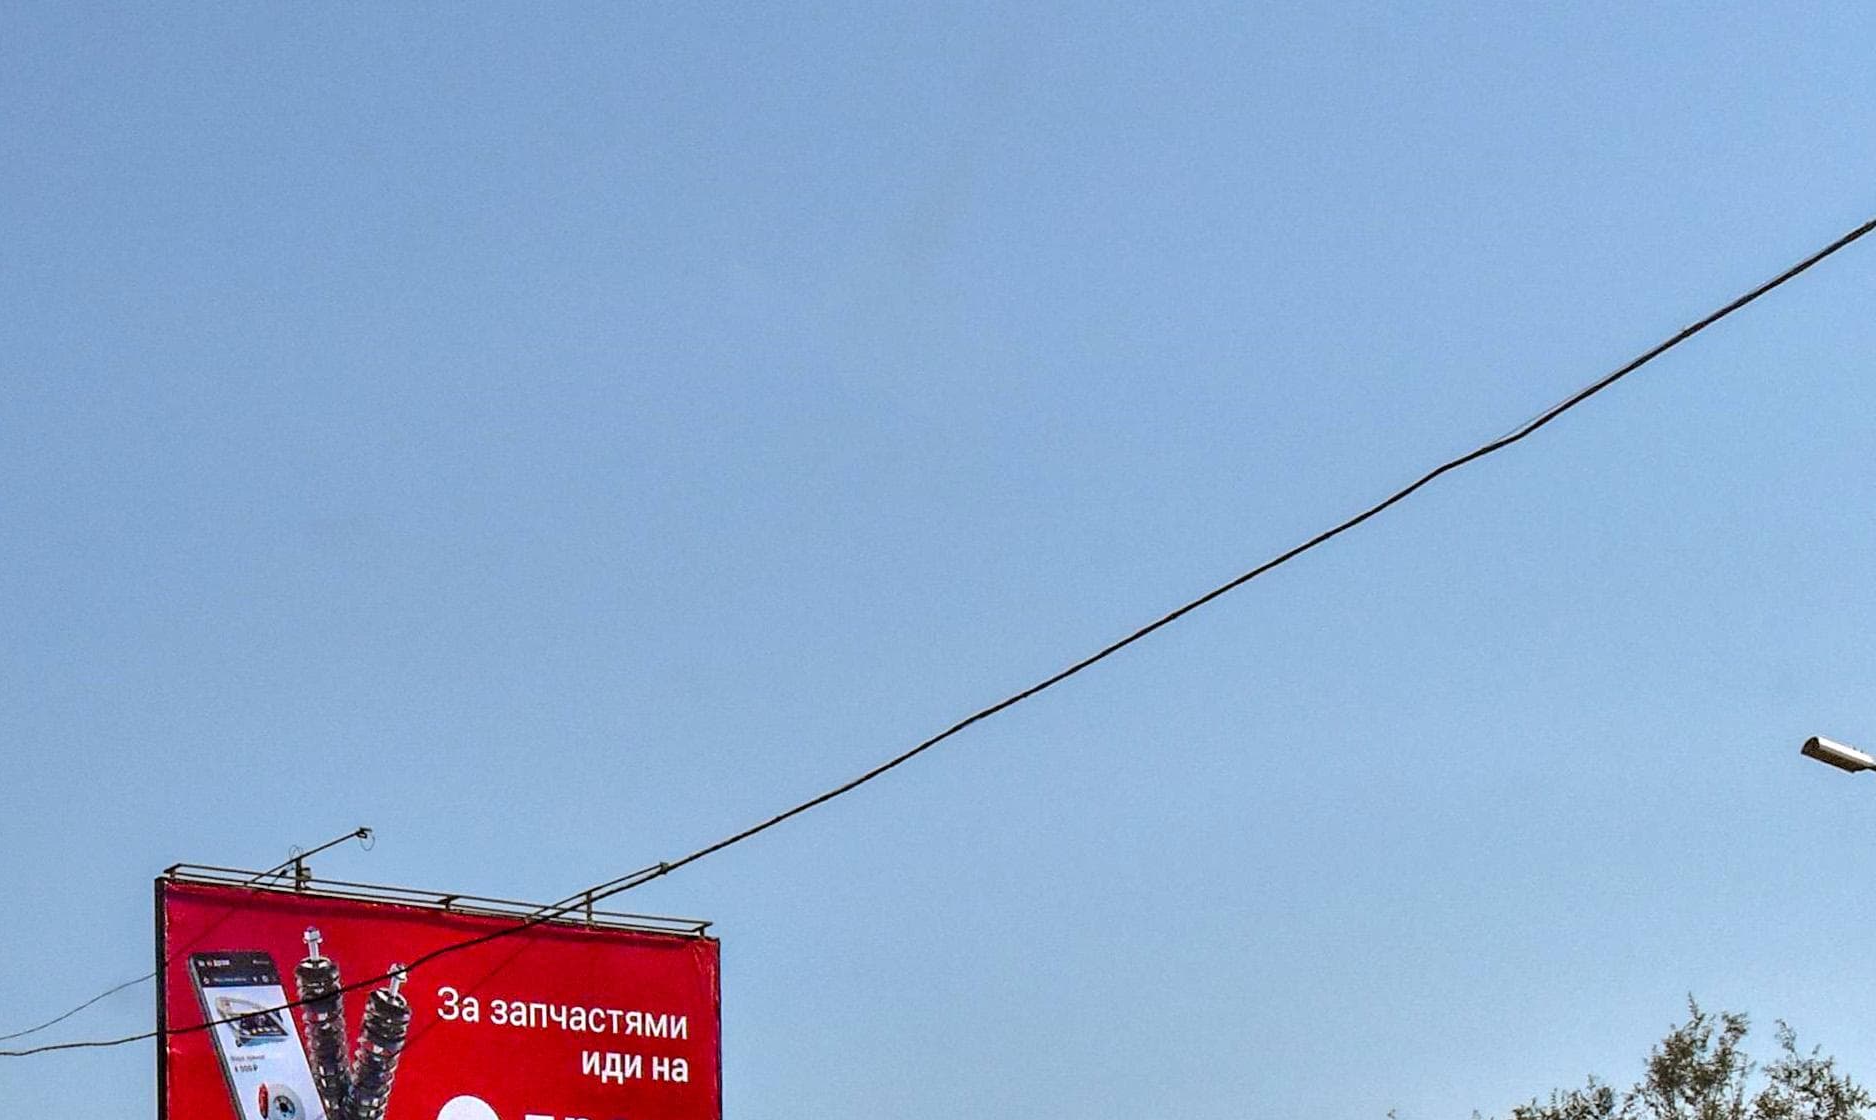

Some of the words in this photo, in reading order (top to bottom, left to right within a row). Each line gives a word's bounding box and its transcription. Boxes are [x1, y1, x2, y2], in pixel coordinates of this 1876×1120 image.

[436, 986, 480, 1022] За
[490, 998, 688, 1040] запчастями
[581, 1050, 642, 1085] иди
[652, 1055, 689, 1083] на
